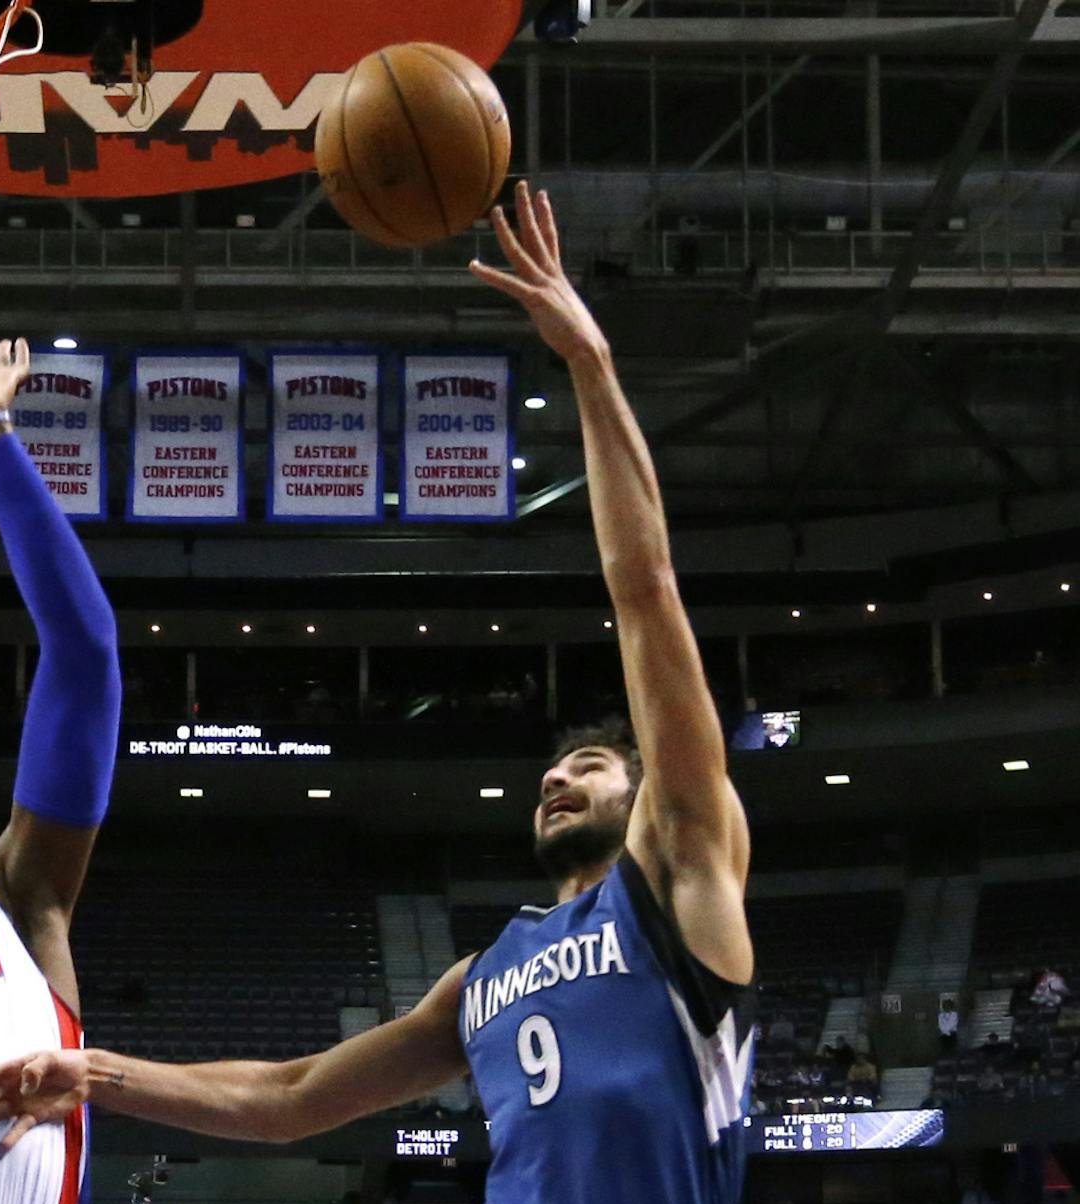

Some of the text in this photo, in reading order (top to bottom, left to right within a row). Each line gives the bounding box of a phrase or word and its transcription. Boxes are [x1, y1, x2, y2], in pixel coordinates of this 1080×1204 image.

[147, 377, 227, 401] PISTONS
[286, 375, 367, 400] PISTONS
[416, 377, 496, 400] PISTONS
[150, 415, 222, 432] 1989-90
[287, 413, 364, 431] 2003-04
[418, 414, 495, 432] 2004-05
[22, 443, 80, 457] ASTERN
[155, 447, 217, 460] EASTERN
[295, 446, 357, 459] EASTERN
[426, 447, 488, 460] EASTERN
[143, 466, 229, 479] CONFERENCE
[282, 464, 369, 477] CONFERENCE
[415, 466, 500, 479] CONFERENCE
[45, 481, 88, 494] PIONS
[147, 485, 225, 498] CHAMPIONS
[286, 484, 364, 497] CHAMPIONS
[418, 485, 496, 498] CHAMPIONS
[129, 741, 331, 755] DE-TROIT BASKET-BALL. #Pistons
[464, 920, 631, 1043] MINNESOTA
[517, 1014, 562, 1107] 9
[782, 1113, 847, 1126] TIMEOUTS
[396, 1129, 459, 1142] T-WOLVES
[765, 1126, 797, 1138] FULL
[396, 1143, 451, 1155] DETROIT
[765, 1138, 797, 1151] FULL
